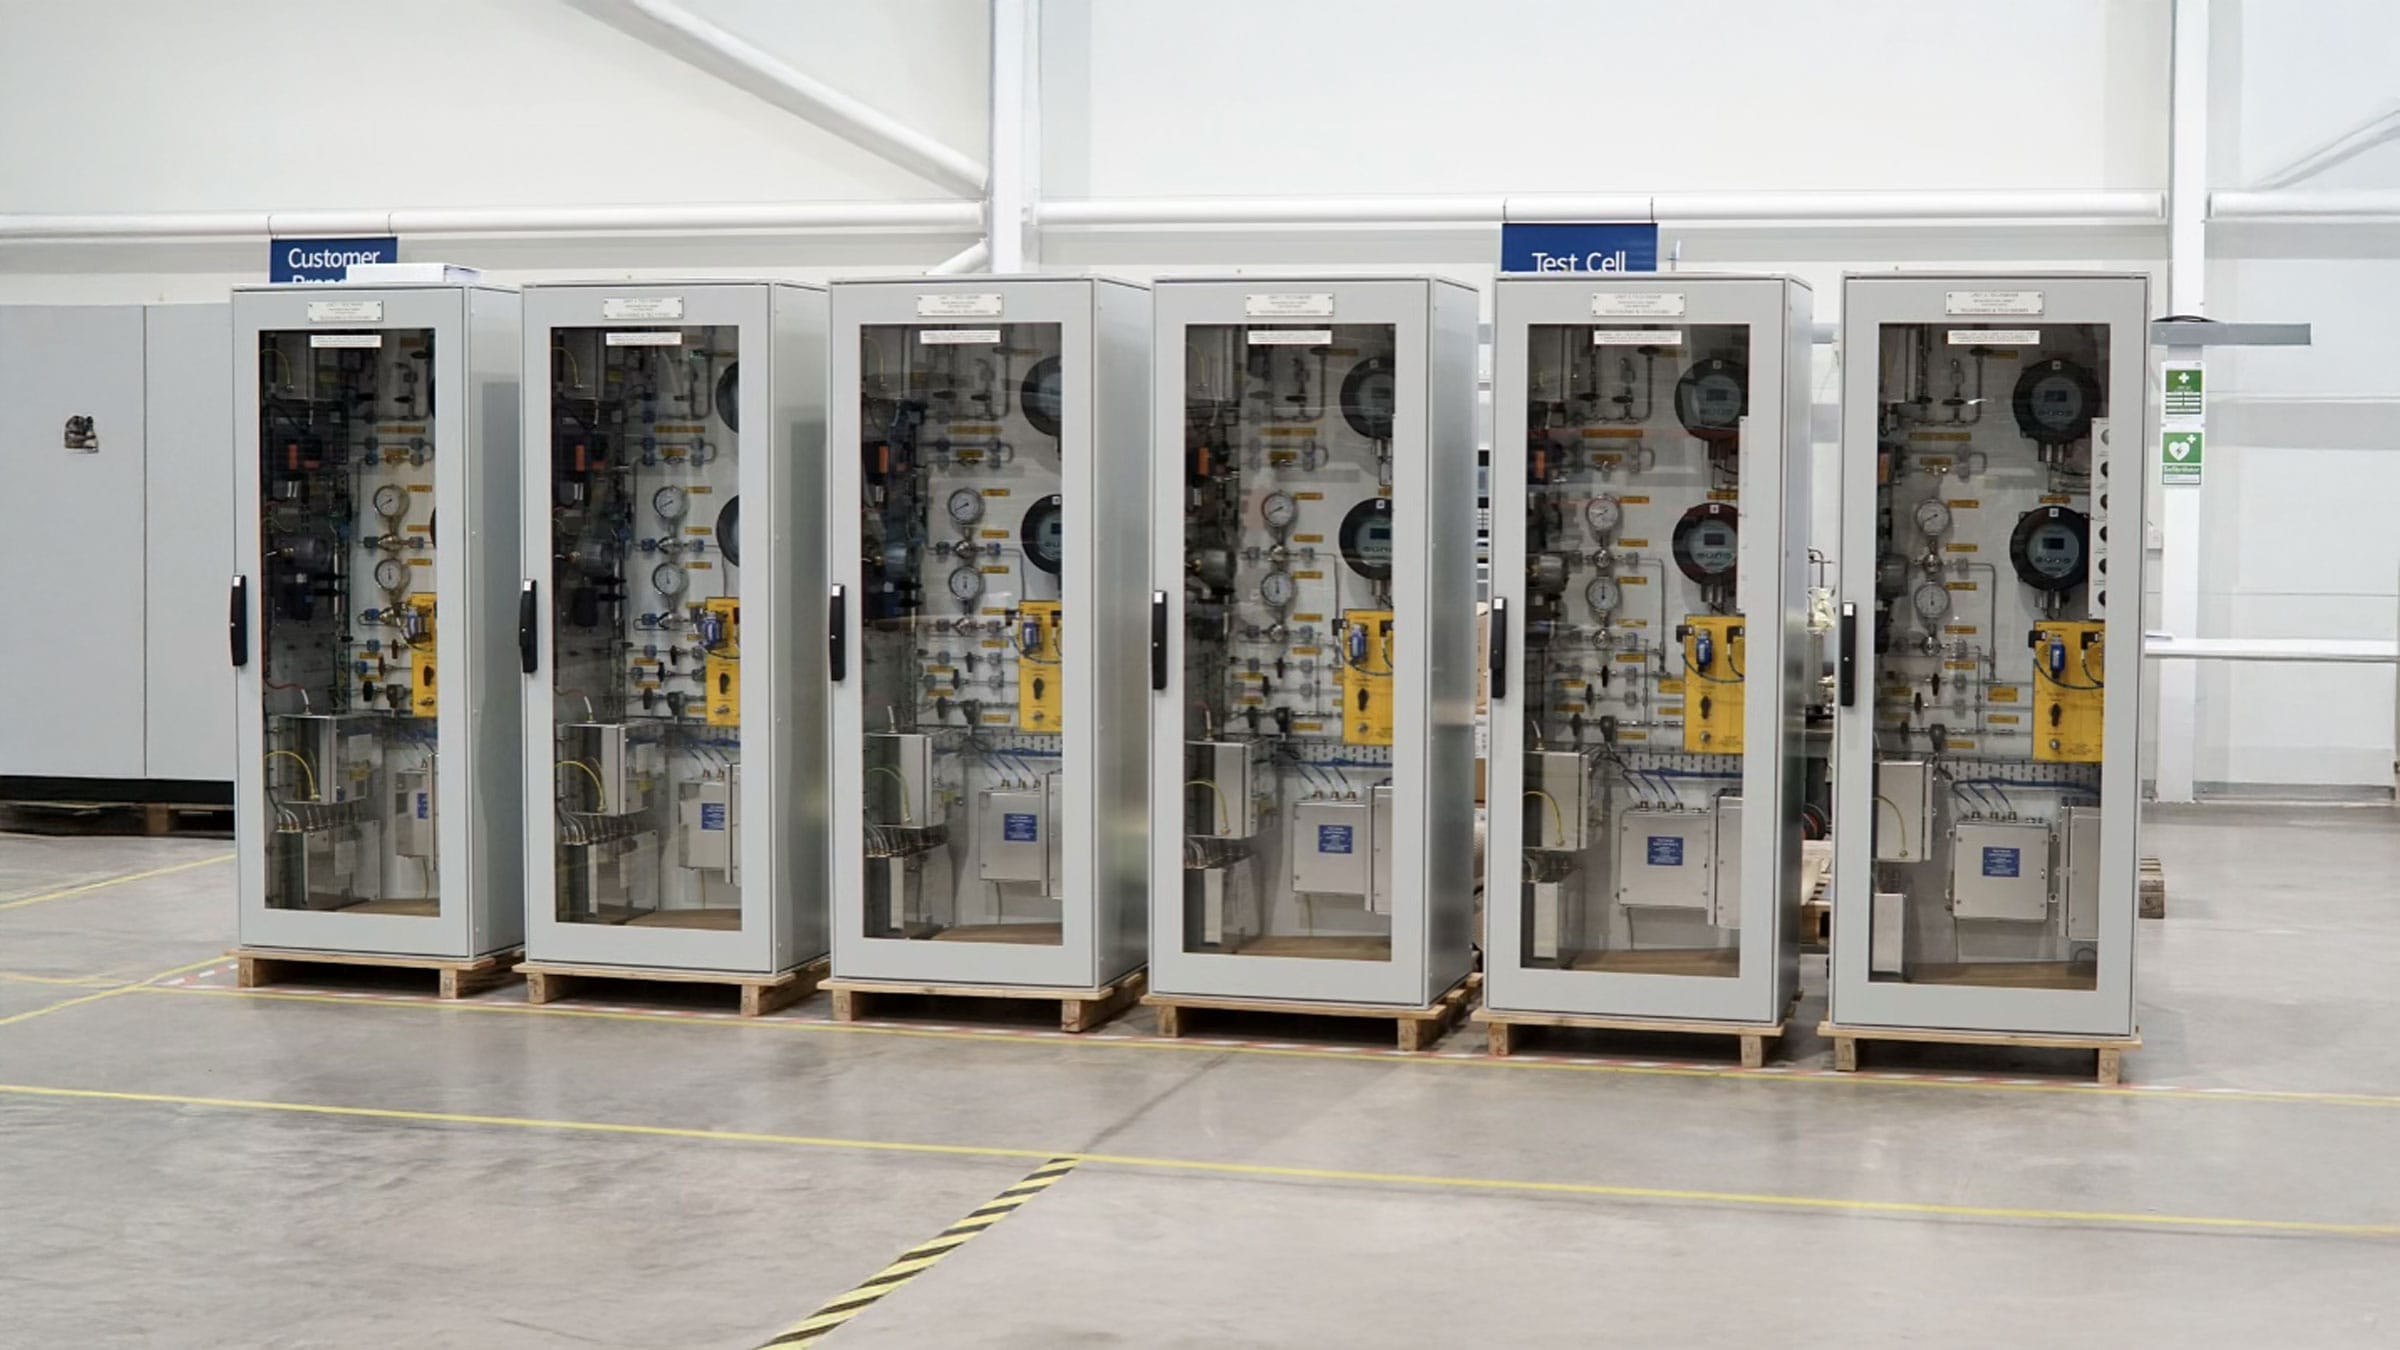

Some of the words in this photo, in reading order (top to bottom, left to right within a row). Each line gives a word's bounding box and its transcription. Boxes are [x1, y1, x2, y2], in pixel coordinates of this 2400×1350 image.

[288, 248, 380, 268] Customer
[1531, 252, 1578, 272] Test
[1586, 250, 1625, 272] Cell
